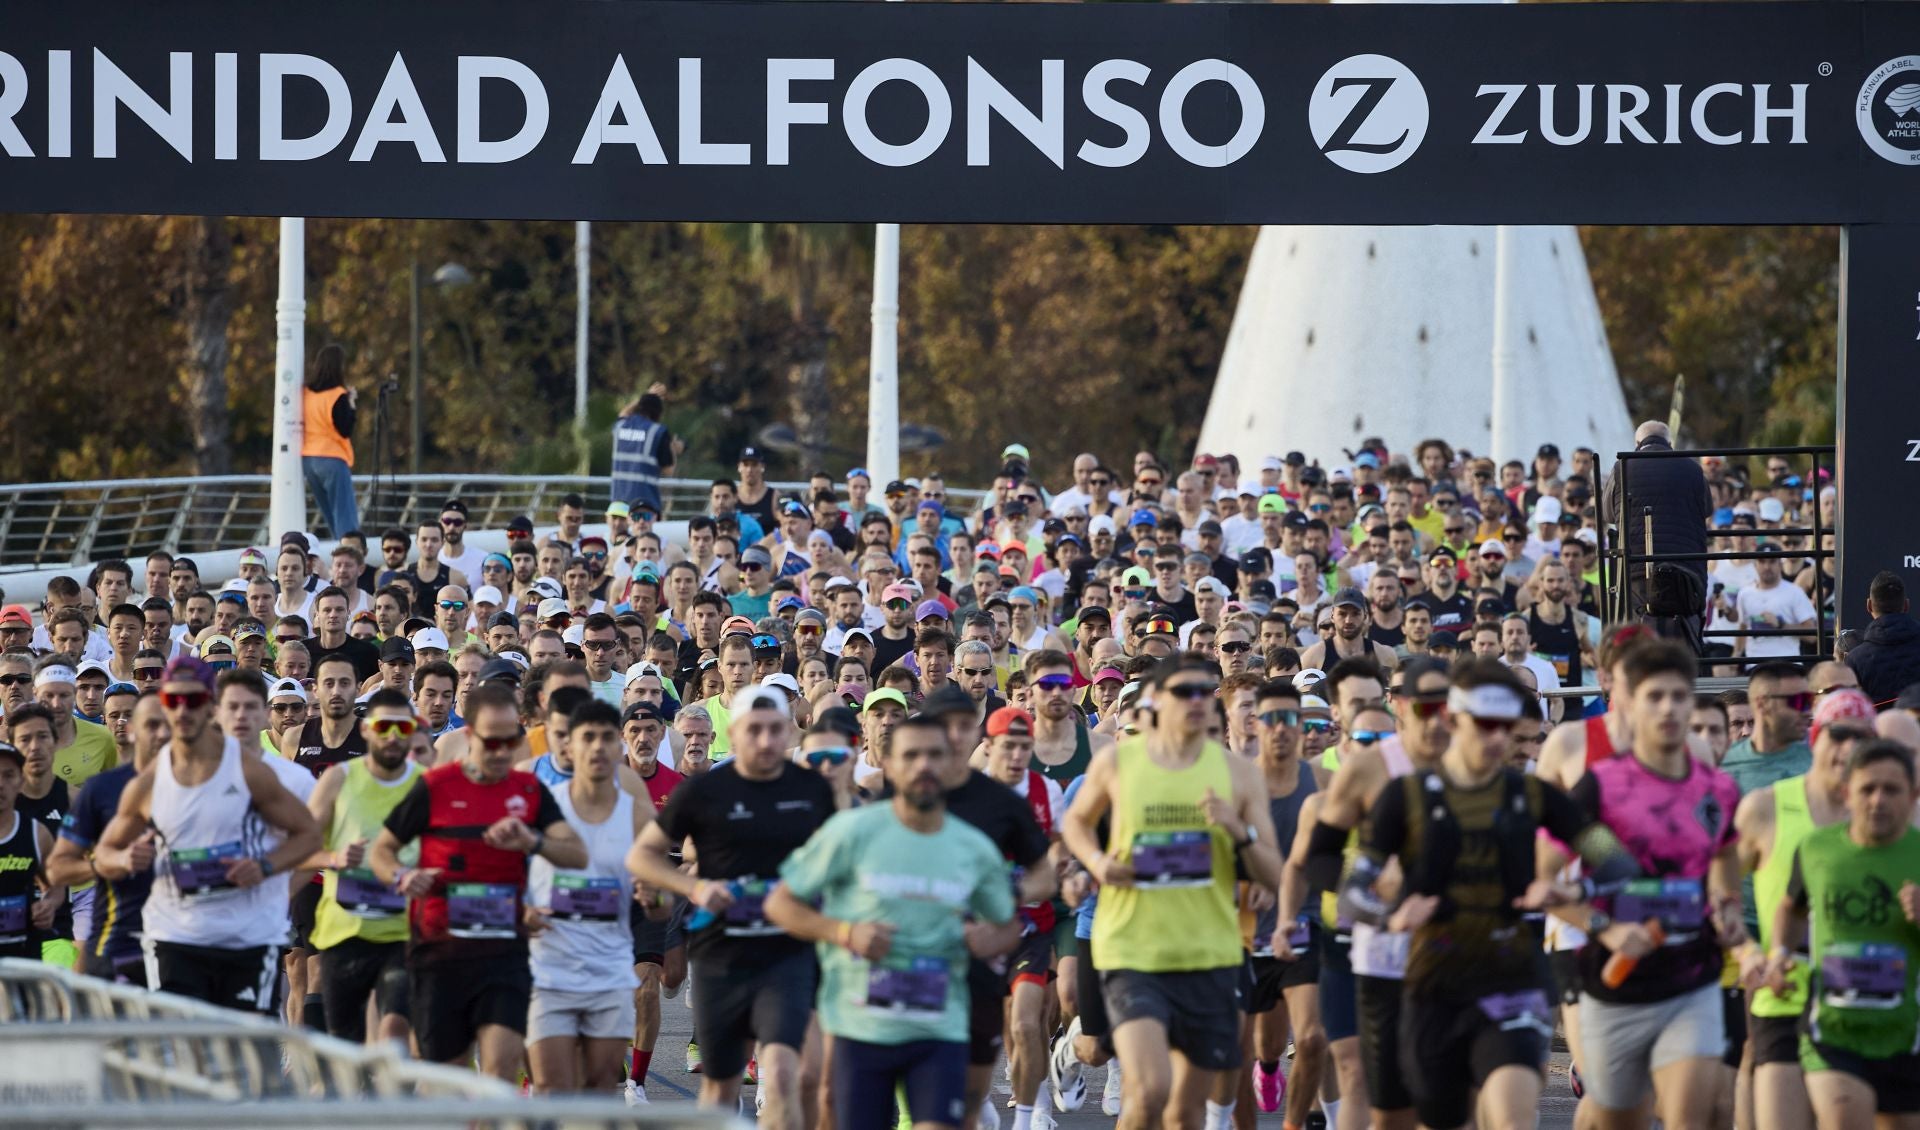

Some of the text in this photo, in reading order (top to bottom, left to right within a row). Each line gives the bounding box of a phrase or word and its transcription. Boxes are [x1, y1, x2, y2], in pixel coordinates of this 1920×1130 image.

[570, 52, 1266, 171] ALFONSO
[1470, 81, 1810, 146] ZURICH
[1860, 59, 1915, 112] PLATINUM LABEL
